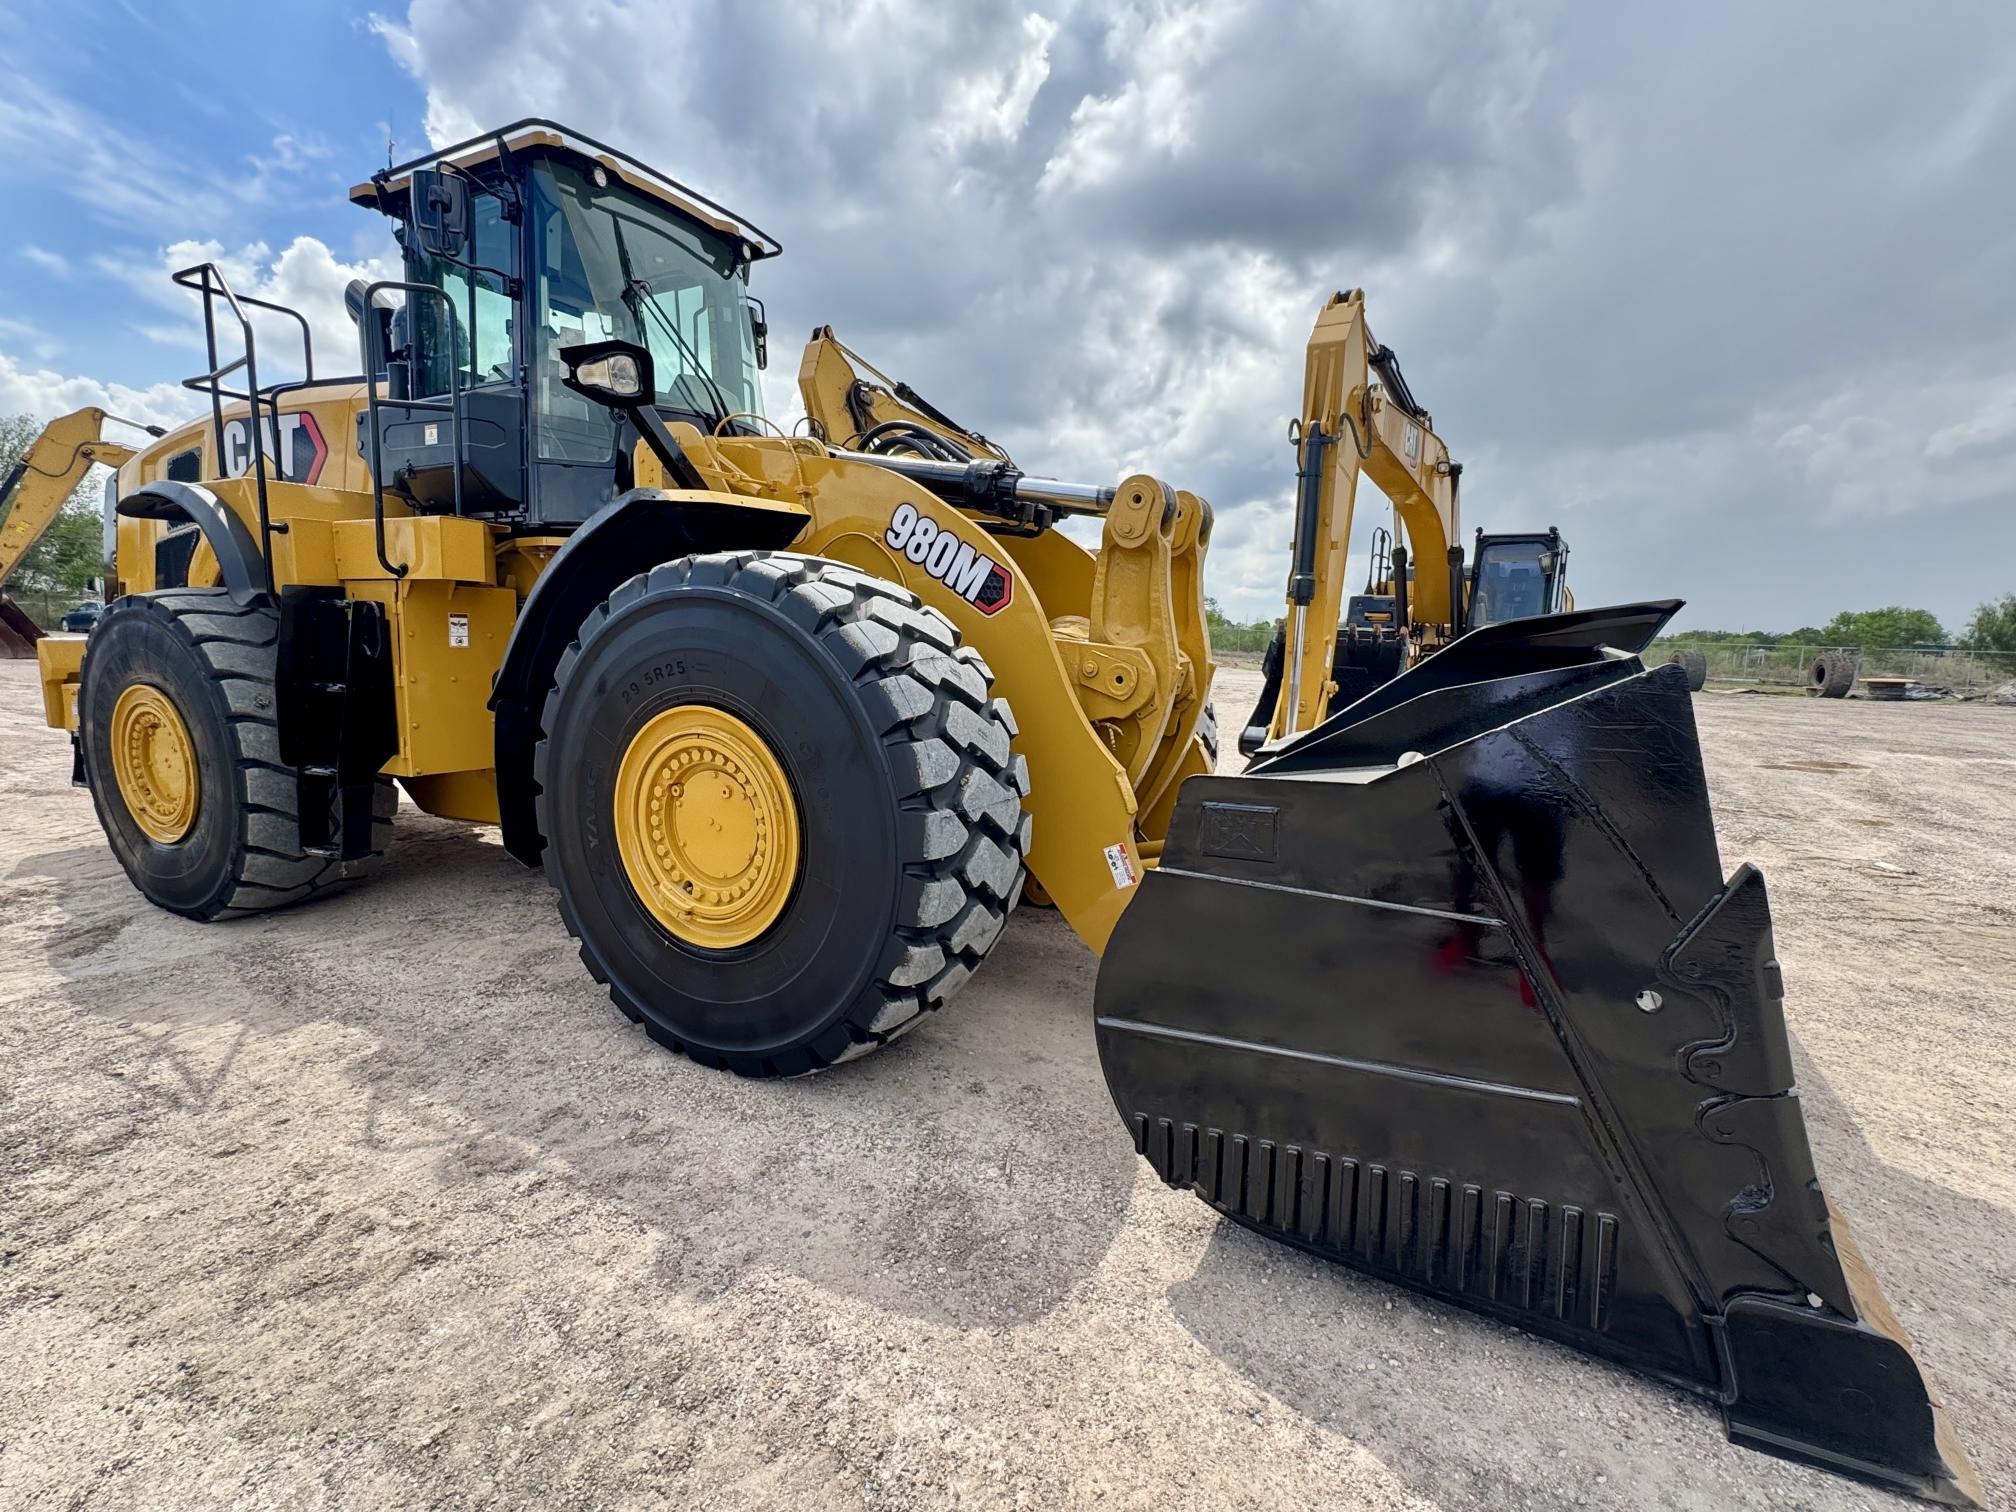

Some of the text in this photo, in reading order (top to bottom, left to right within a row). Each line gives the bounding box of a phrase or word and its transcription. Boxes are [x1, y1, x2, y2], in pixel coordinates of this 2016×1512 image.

[223, 413, 300, 478] CAT
[886, 502, 994, 603] 980M
[621, 660, 687, 705] 295R25
